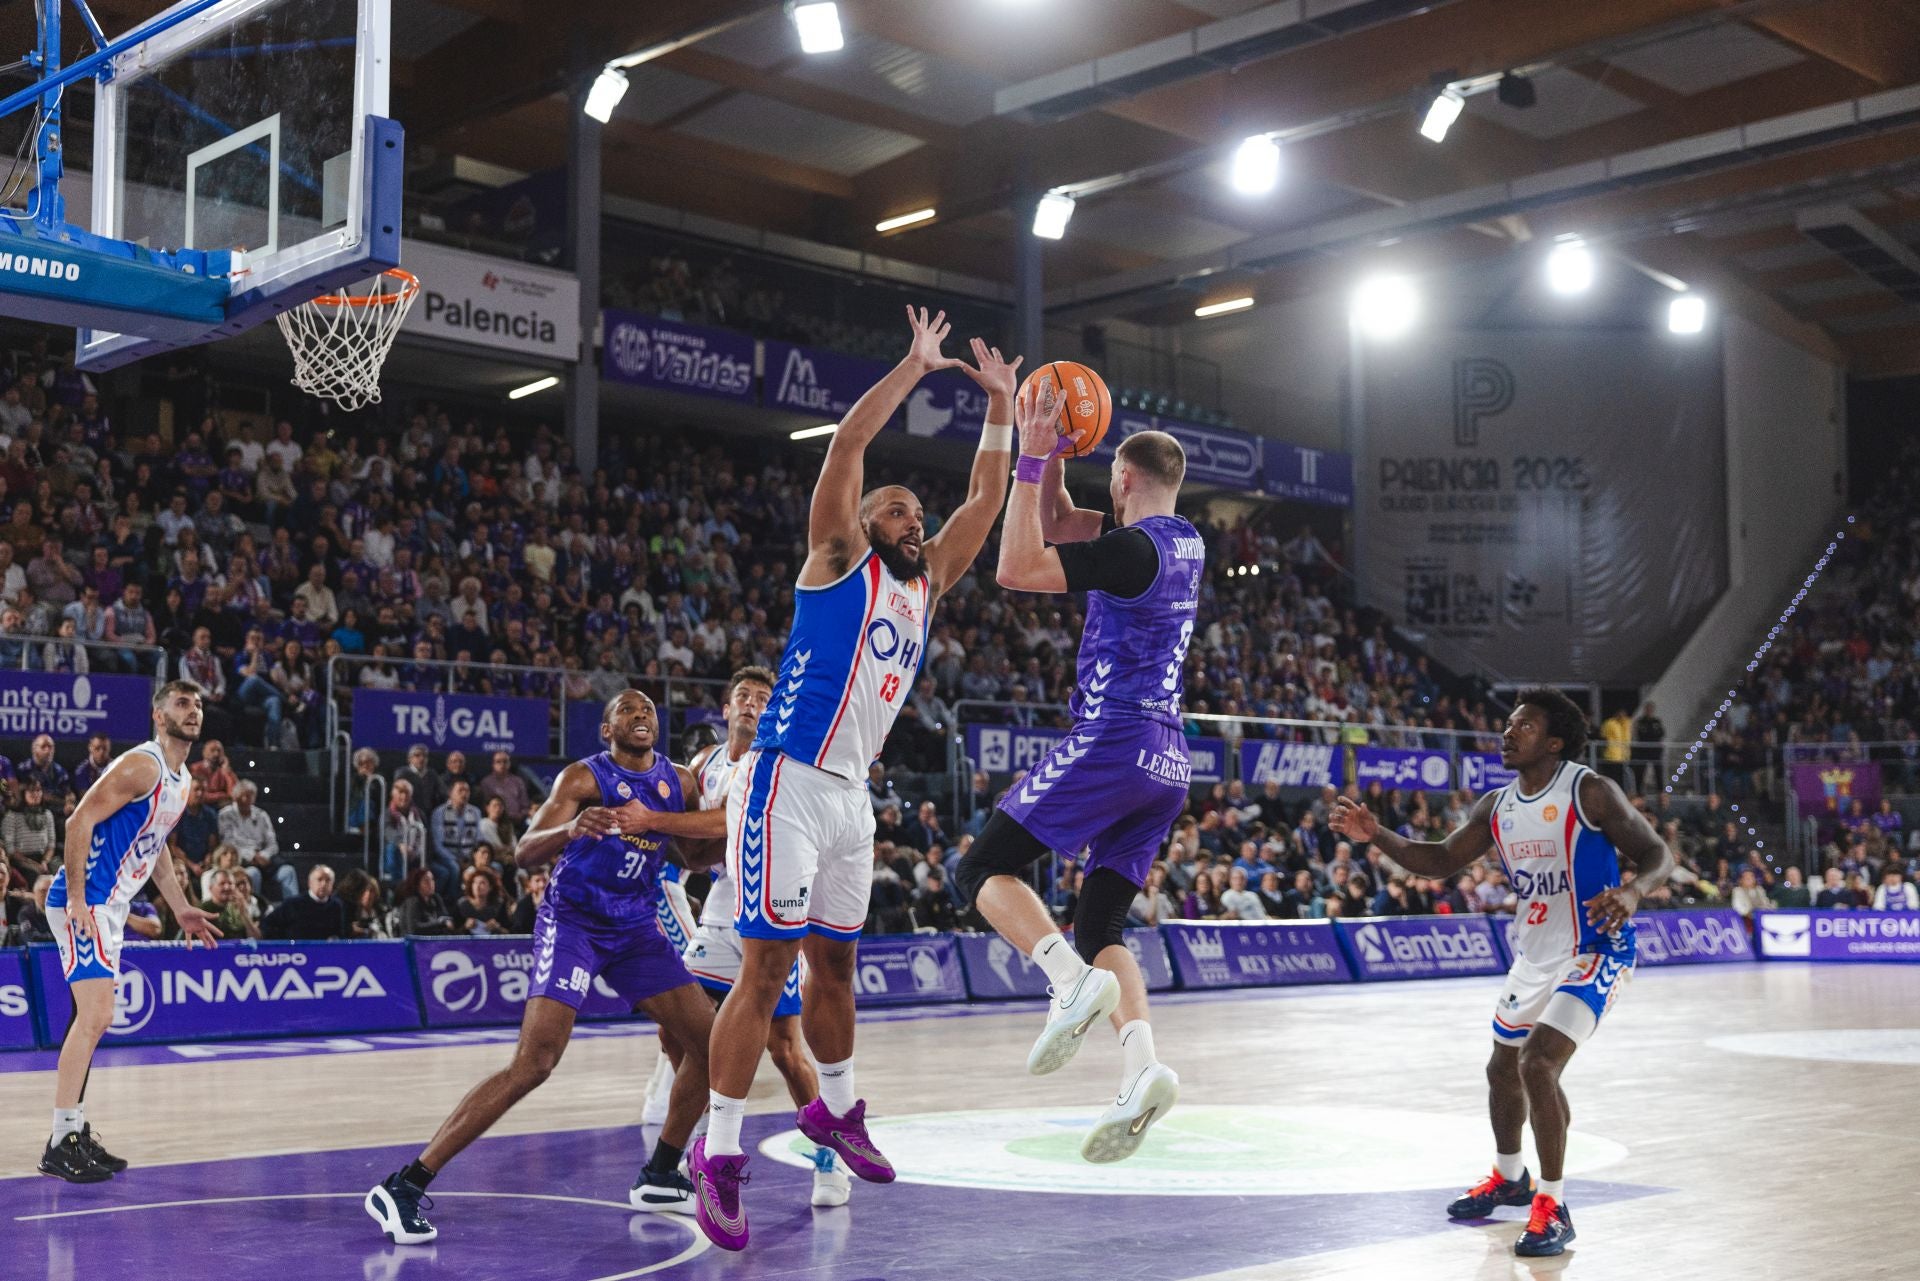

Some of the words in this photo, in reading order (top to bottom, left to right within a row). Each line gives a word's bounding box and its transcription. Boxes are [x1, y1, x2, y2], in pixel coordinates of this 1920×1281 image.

[0, 252, 80, 281] MONDO
[425, 291, 556, 343] Palencia
[653, 343, 752, 394] Valdés
[879, 672, 901, 703] 13
[617, 852, 647, 880] 31
[771, 898, 804, 908] suma
[1527, 902, 1548, 925] 22
[1238, 930, 1315, 947] HOTEL
[1381, 924, 1494, 962] lambda
[235, 953, 308, 968] GRUPO
[1271, 952, 1337, 975] SANCHO
[161, 965, 387, 1004] INMAPA
